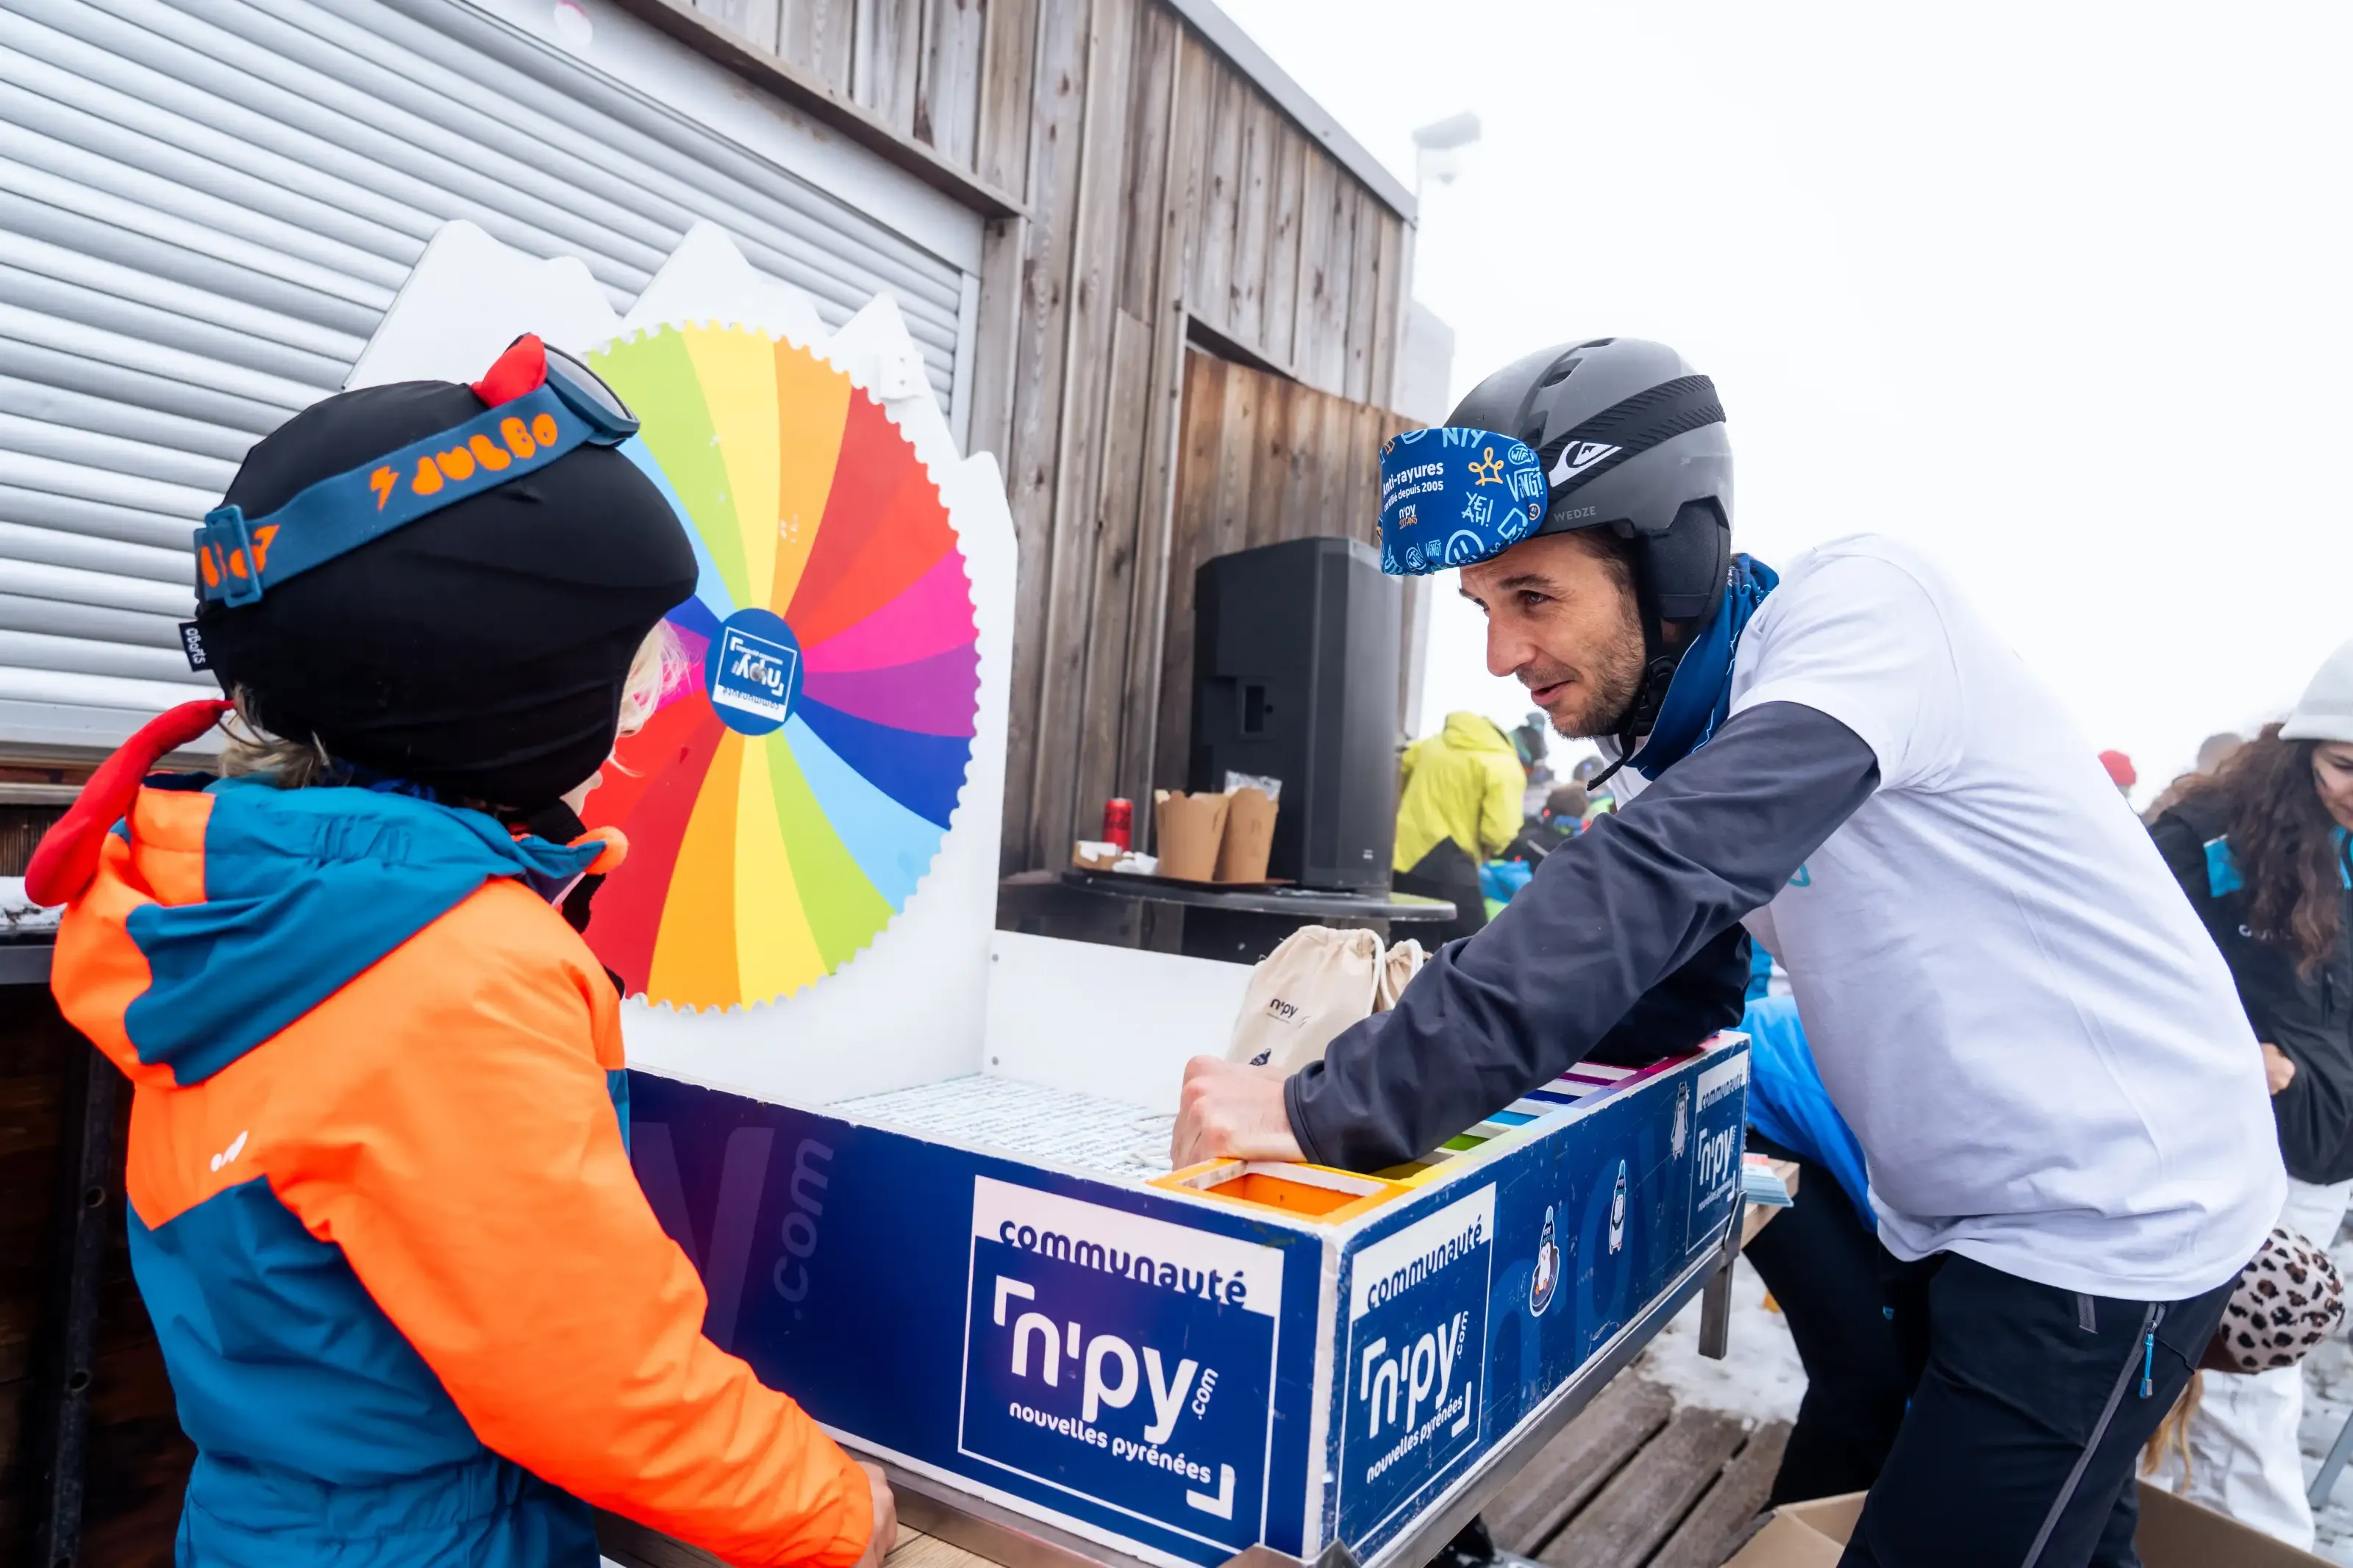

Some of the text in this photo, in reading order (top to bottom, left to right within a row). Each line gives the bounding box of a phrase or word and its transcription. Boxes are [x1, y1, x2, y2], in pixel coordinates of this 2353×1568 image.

[411, 412, 559, 496] JULBO
[1382, 462, 1444, 498] Anti-rayures
[1398, 484, 1421, 500] depuis
[1421, 480, 1444, 493] 2005
[1399, 504, 1416, 520] n'py
[1553, 506, 1596, 523] WEDZE
[1270, 998, 1299, 1018] n'py
[1701, 1067, 1743, 1109] communauté
[1699, 1125, 1735, 1190] n'py
[773, 1138, 835, 1321] .com
[999, 1220, 1248, 1307] communauté
[1367, 1214, 1482, 1311] communauté
[1011, 1311, 1219, 1445] n'py .com
[1368, 1310, 1470, 1439] n'py .com
[1009, 1401, 1212, 1485] nouvelles pyrénées
[1366, 1395, 1463, 1484] nouvelles pyrénées
